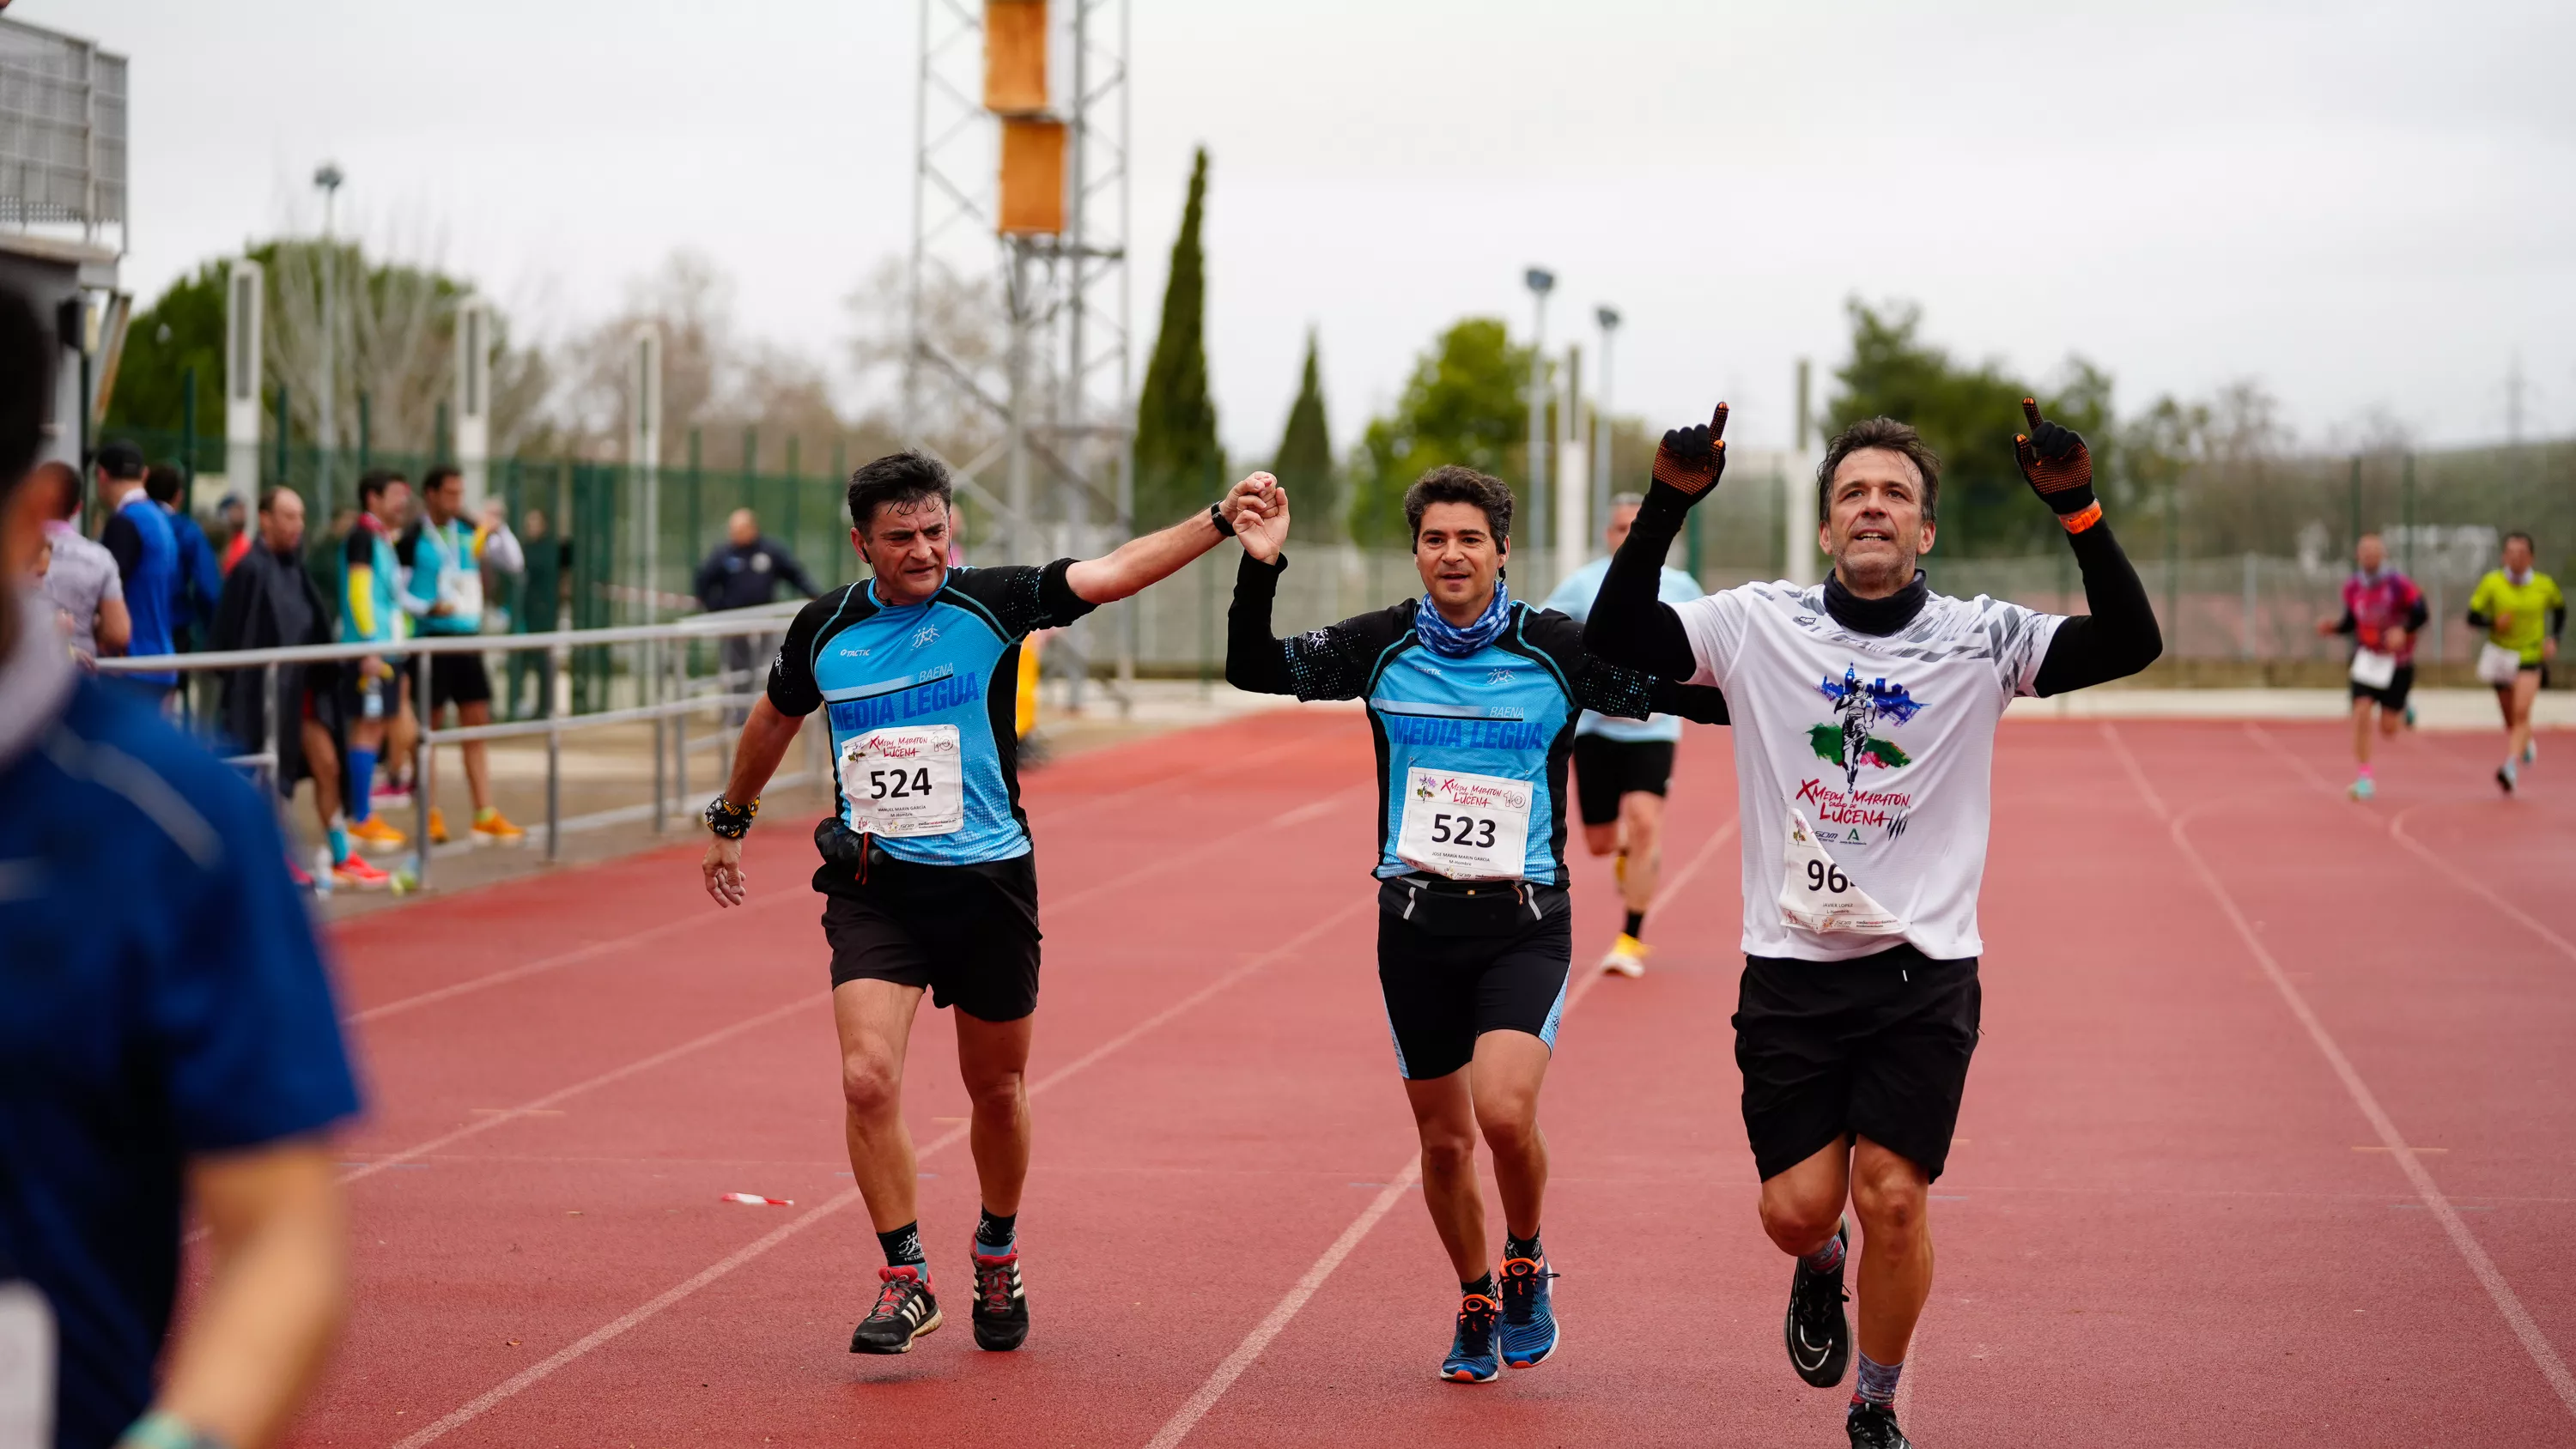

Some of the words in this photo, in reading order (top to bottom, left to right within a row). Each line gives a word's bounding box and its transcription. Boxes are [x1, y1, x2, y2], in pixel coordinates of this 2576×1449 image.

[847, 649, 871, 658] TACTIC
[919, 662, 954, 682] BAENA
[829, 695, 895, 731] MEDIA
[903, 671, 980, 719] LEGUA
[1490, 706, 1524, 718] BAENA
[1394, 717, 1461, 747] MEDIA
[1469, 721, 1543, 750] LEGUA
[884, 748, 920, 758] LUCENA
[871, 767, 932, 799] 524
[1453, 792, 1492, 808] LUCENA
[1820, 802, 1893, 827] LUCENA
[1432, 814, 1496, 848] 523
[1807, 859, 1856, 894] 96
